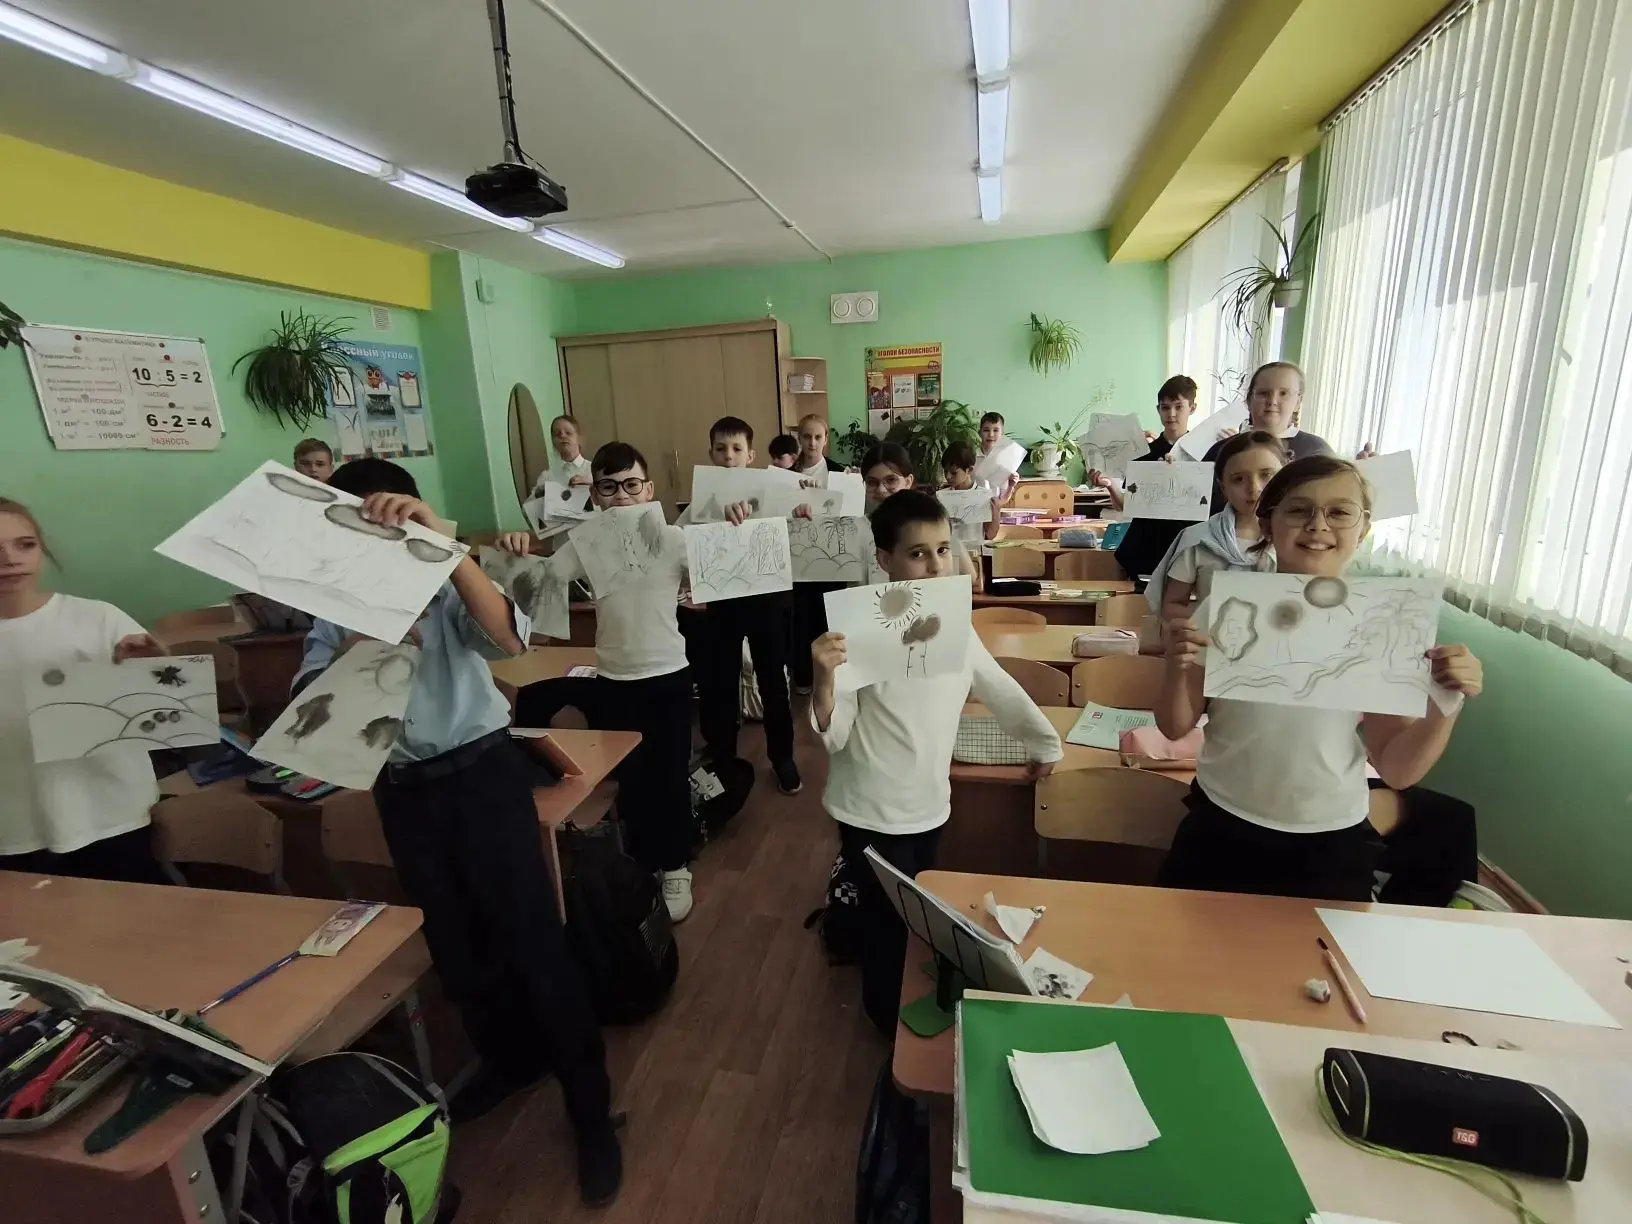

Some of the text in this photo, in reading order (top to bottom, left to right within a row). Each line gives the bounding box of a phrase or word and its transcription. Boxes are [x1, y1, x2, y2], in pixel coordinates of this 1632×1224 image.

[898, 346, 940, 356] БЕЗОПАСНОСТИ
[132, 368, 150, 380] 10
[166, 370, 175, 382] 5
[193, 372, 202, 383] 2
[146, 414, 158, 426] 6
[171, 415, 183, 427] 2
[201, 416, 212, 428] 4
[151, 437, 190, 446] РАЗНОСТЬ
